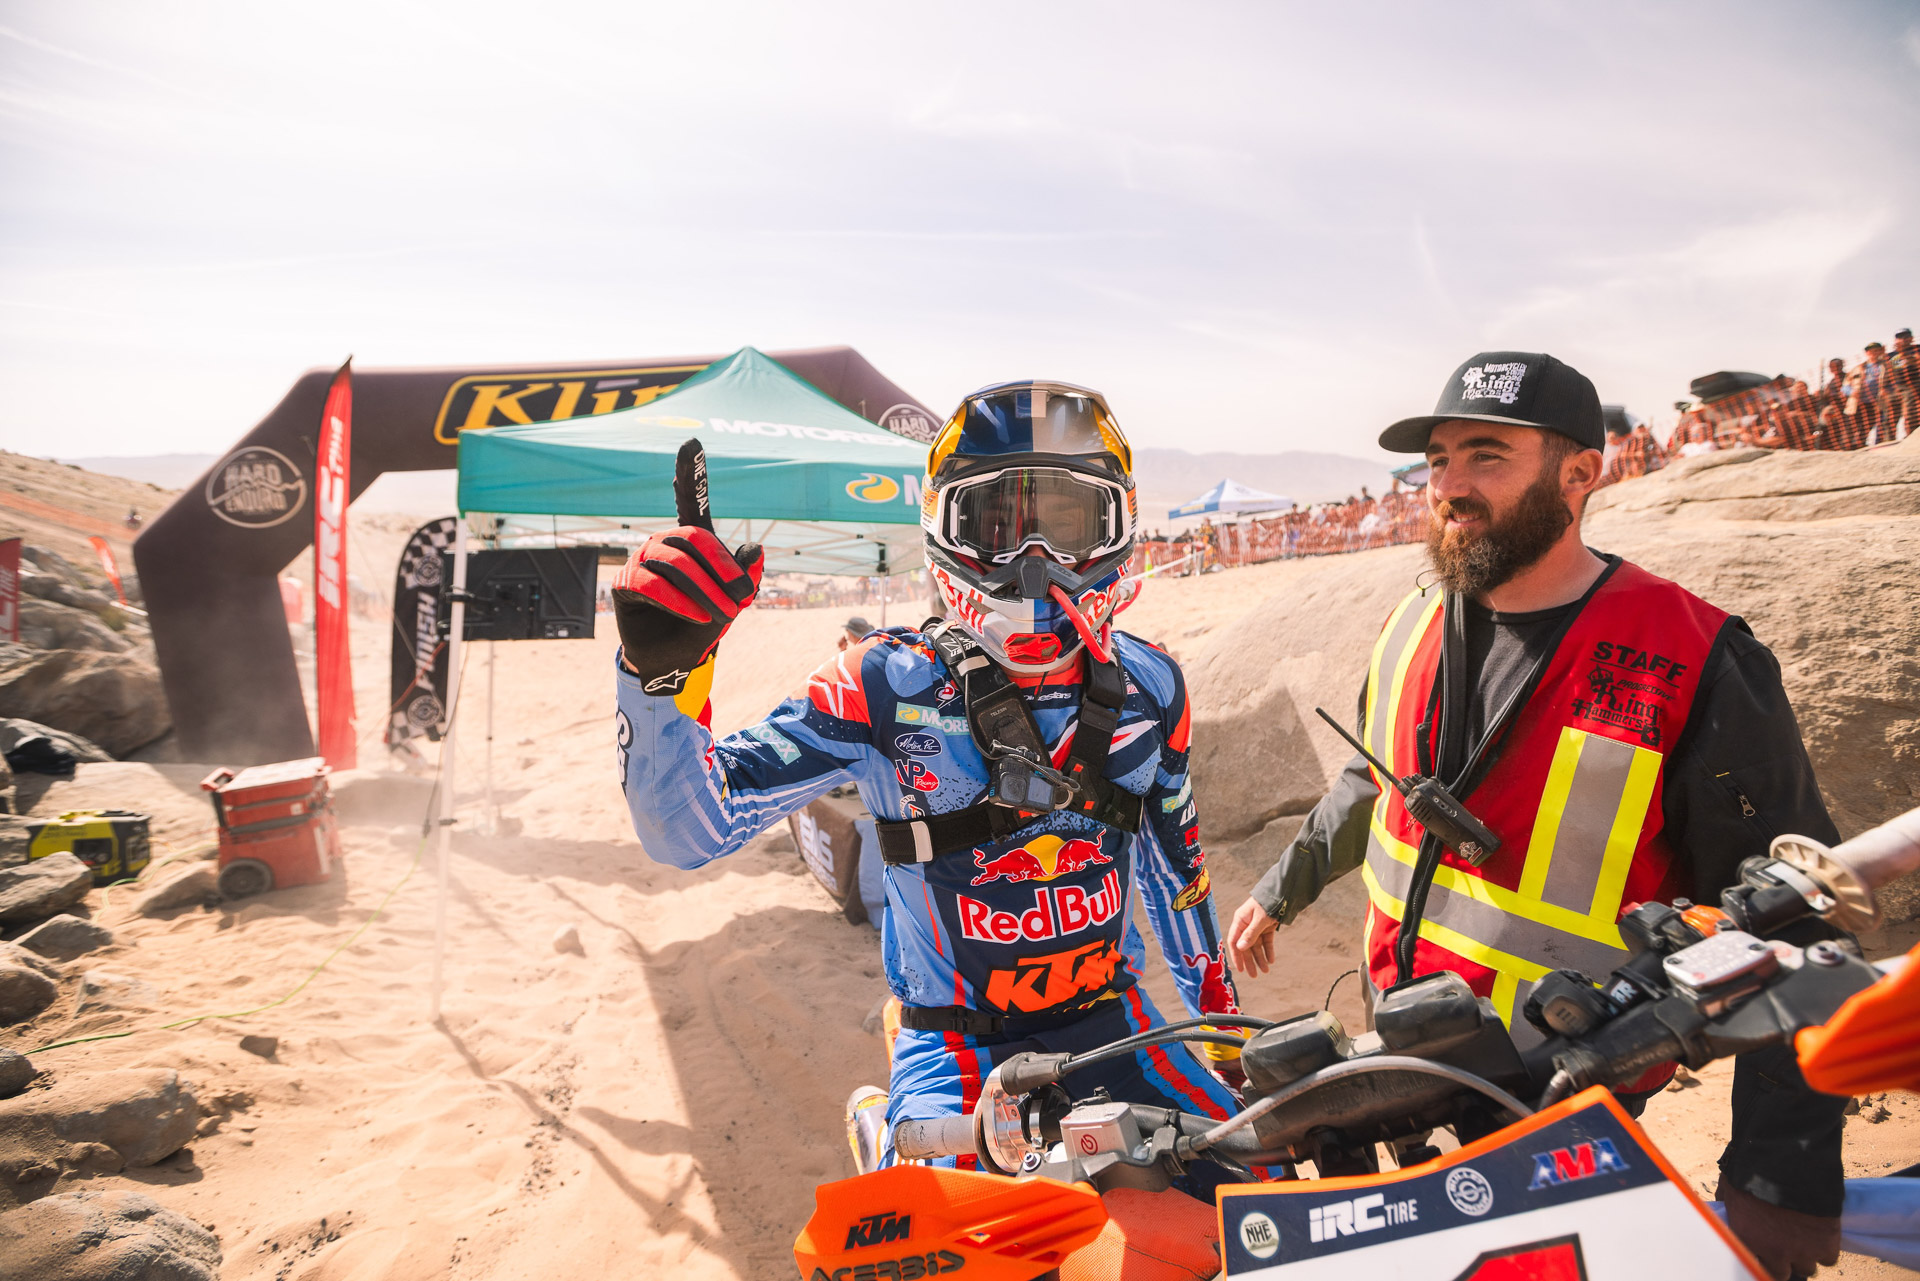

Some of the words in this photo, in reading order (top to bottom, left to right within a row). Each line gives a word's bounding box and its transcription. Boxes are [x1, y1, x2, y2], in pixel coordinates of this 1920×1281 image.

[694, 449, 706, 481] ONE
[695, 478, 709, 517] GOAL
[1593, 641, 1688, 682] STAFF
[1571, 698, 1644, 729] Hammers
[895, 759, 926, 788] VP
[957, 887, 1056, 944] Red
[1053, 867, 1122, 937] Bull
[985, 939, 1122, 1013] KTM
[1527, 1136, 1631, 1192] AMA
[1384, 1199, 1419, 1226] TIRE
[844, 1211, 911, 1251] KTM
[1245, 1223, 1272, 1244] NHE
[808, 1249, 966, 1281] ACERBIS
